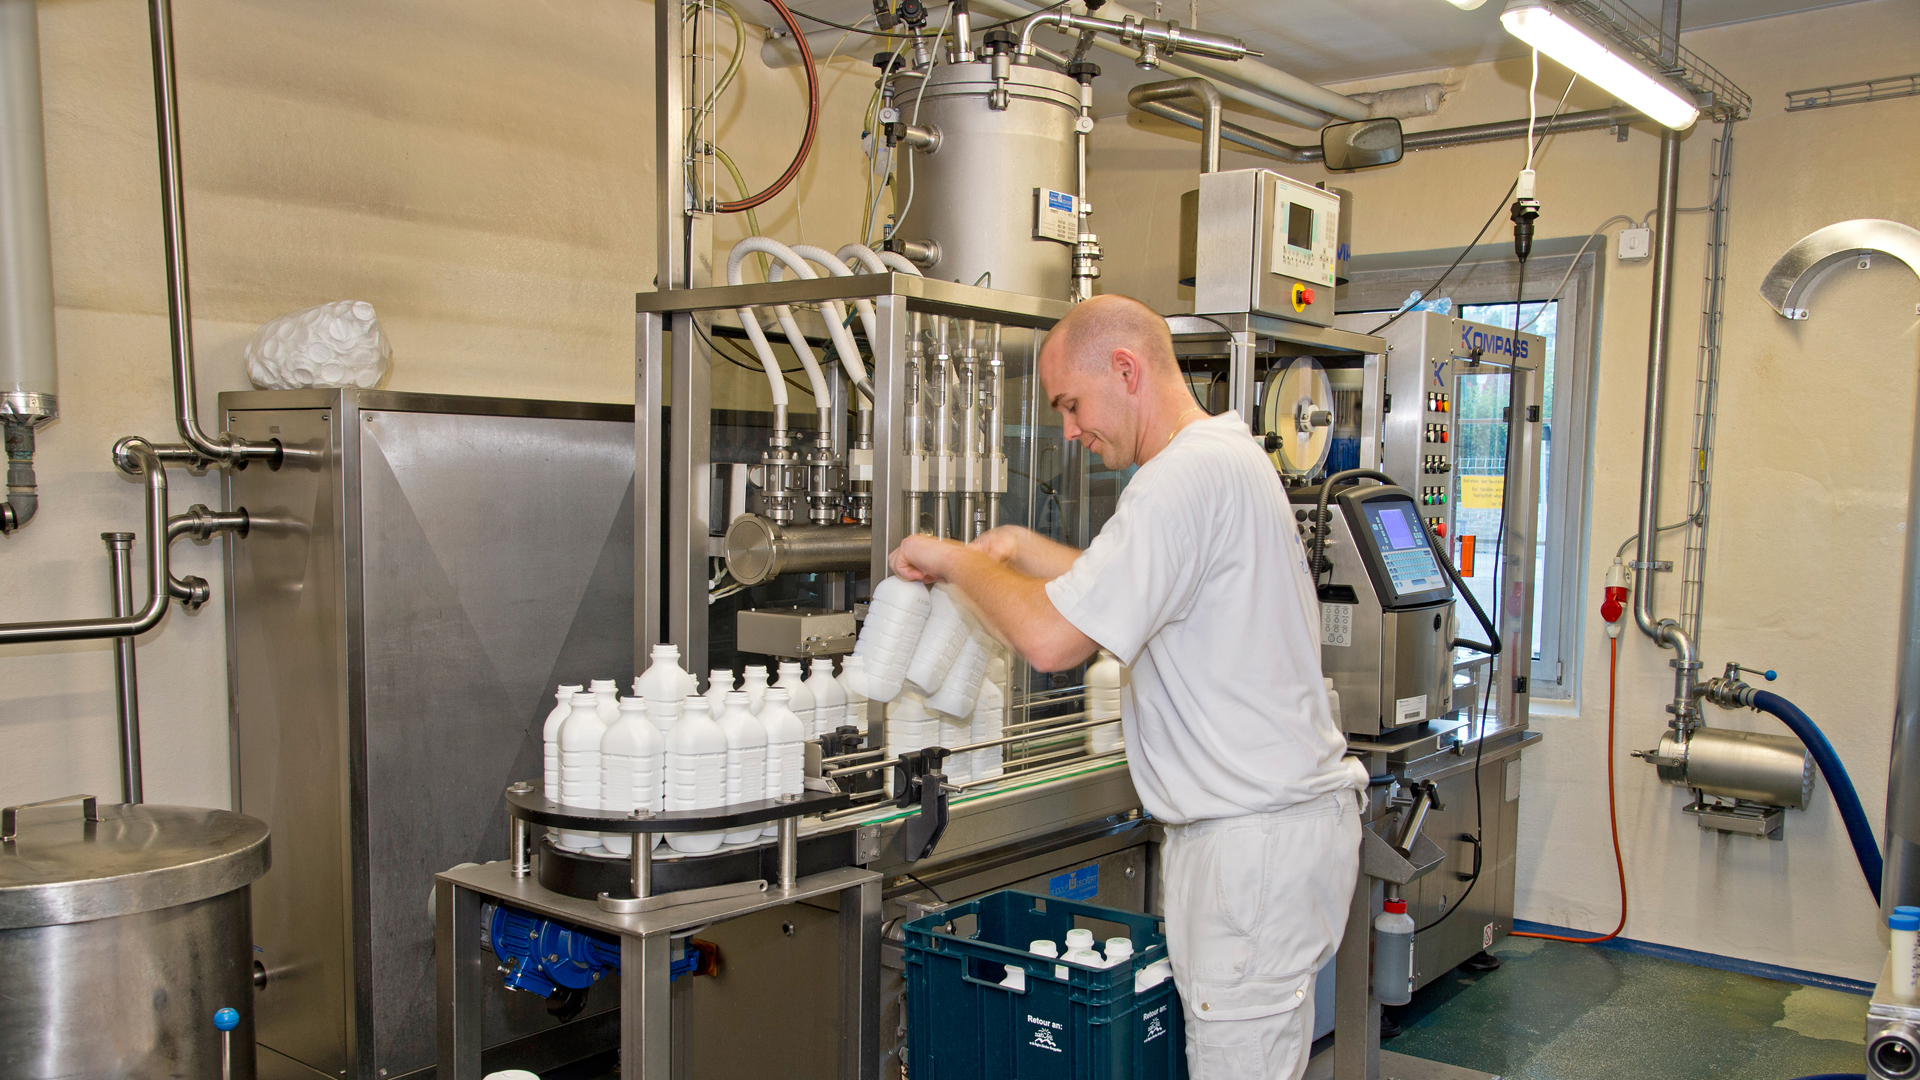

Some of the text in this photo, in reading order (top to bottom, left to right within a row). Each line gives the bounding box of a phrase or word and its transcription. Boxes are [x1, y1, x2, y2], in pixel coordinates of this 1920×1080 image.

[1461, 325, 1529, 359] KOMPASS
[1027, 1014, 1063, 1031] Retour an:
[1143, 1008, 1159, 1022] Retour
